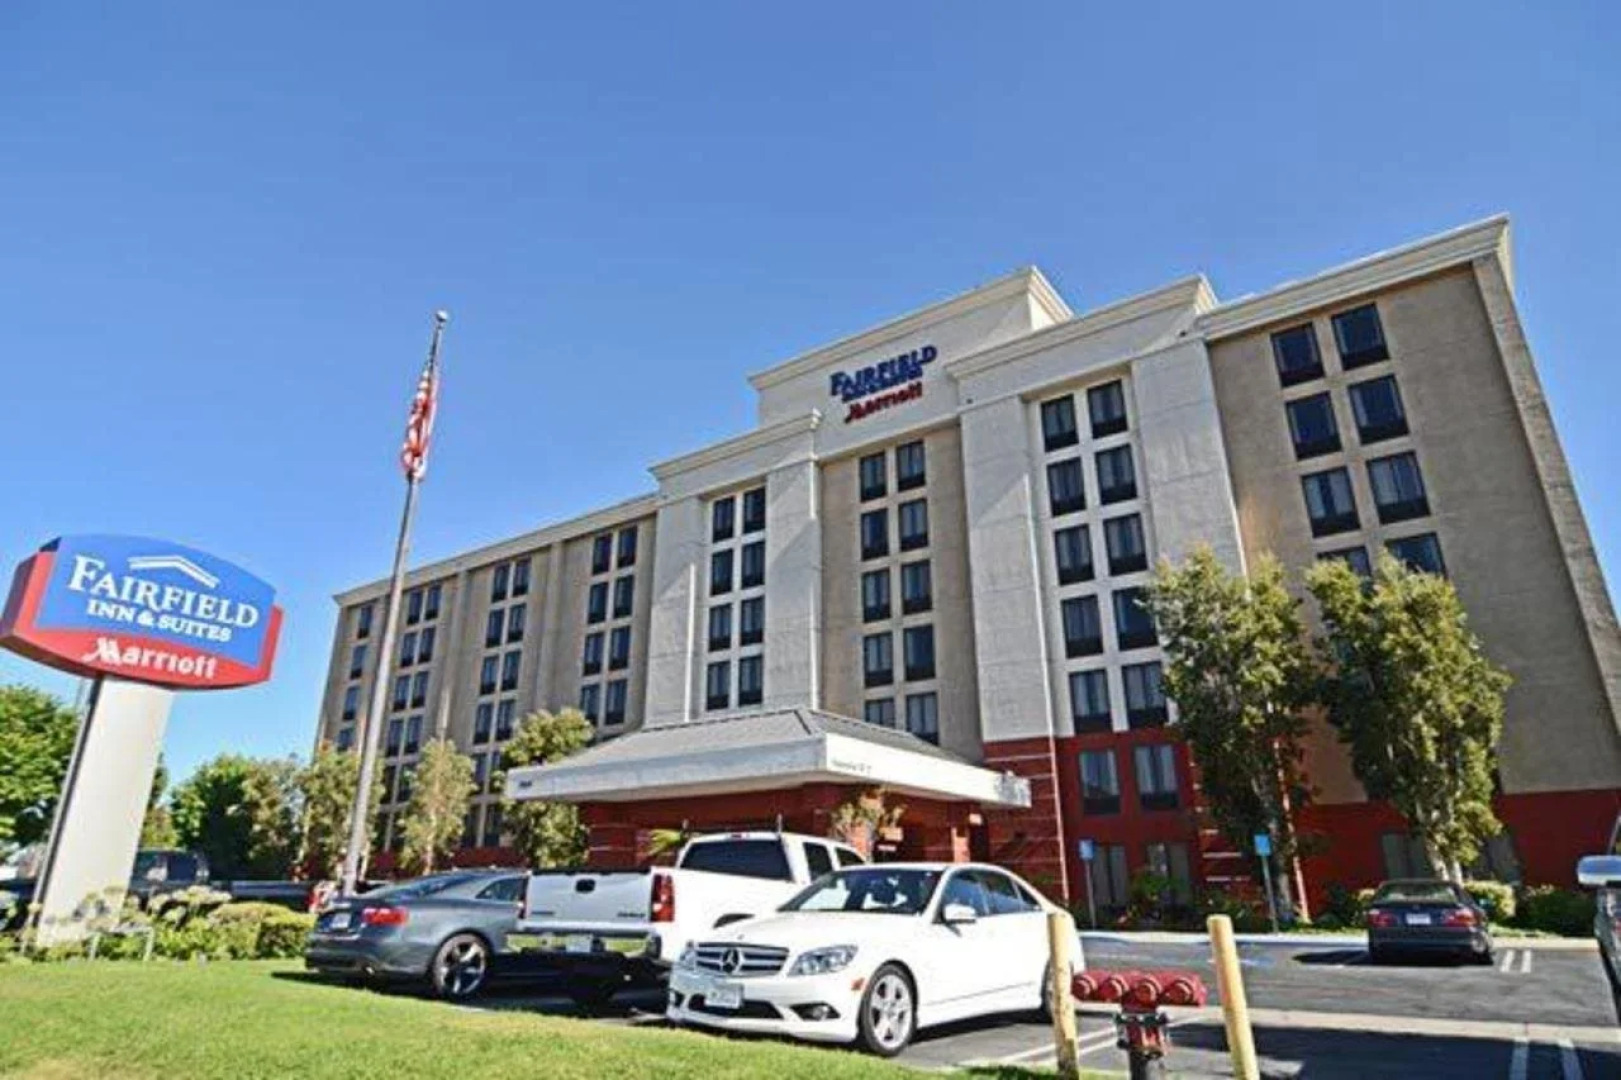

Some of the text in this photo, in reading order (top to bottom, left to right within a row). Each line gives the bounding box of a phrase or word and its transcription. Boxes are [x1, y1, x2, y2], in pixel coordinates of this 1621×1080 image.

[830, 344, 937, 397] FAIRFIELD
[67, 554, 259, 628] FAIRFIELD
[87, 599, 232, 642] INN & SUITES
[82, 637, 219, 679] Marriott
